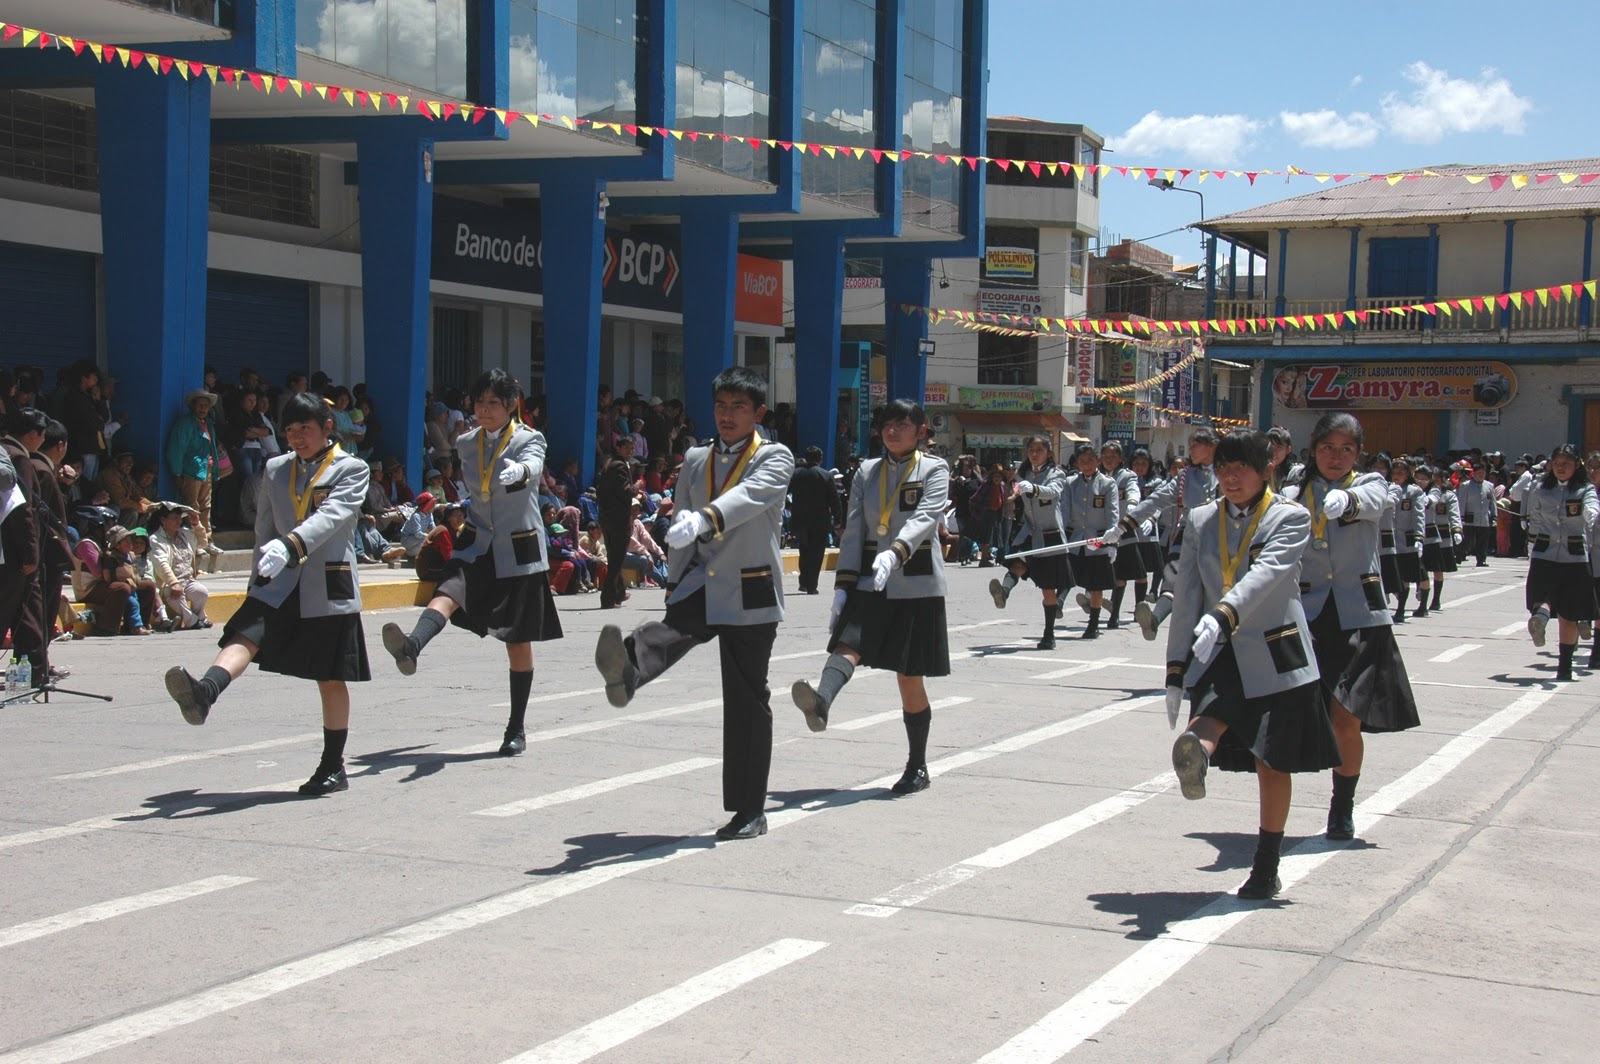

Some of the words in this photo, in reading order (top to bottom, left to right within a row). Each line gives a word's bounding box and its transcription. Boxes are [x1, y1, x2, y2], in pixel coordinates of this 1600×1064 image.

[455, 223, 511, 264] Banco
[513, 235, 535, 267] de
[619, 238, 665, 286] BCP
[988, 251, 1033, 264] POLICLINICO
[743, 272, 778, 297] ViaBCP
[845, 278, 880, 288] ECOGRAFIA
[982, 293, 1040, 302] ECOGRAFIAS
[1344, 367, 1366, 377] SUPER
[1367, 366, 1415, 377] LABORATORIO
[1416, 366, 1465, 376] FOTOGRAFICO
[1466, 365, 1494, 376] DIGITAL
[1108, 347, 1119, 419] LOCUTIO
[1166, 352, 1178, 410] DEISTA
[1308, 366, 1441, 402] Zamyra
[981, 391, 997, 400] CAFE
[1107, 431, 1133, 439] SAVIN
